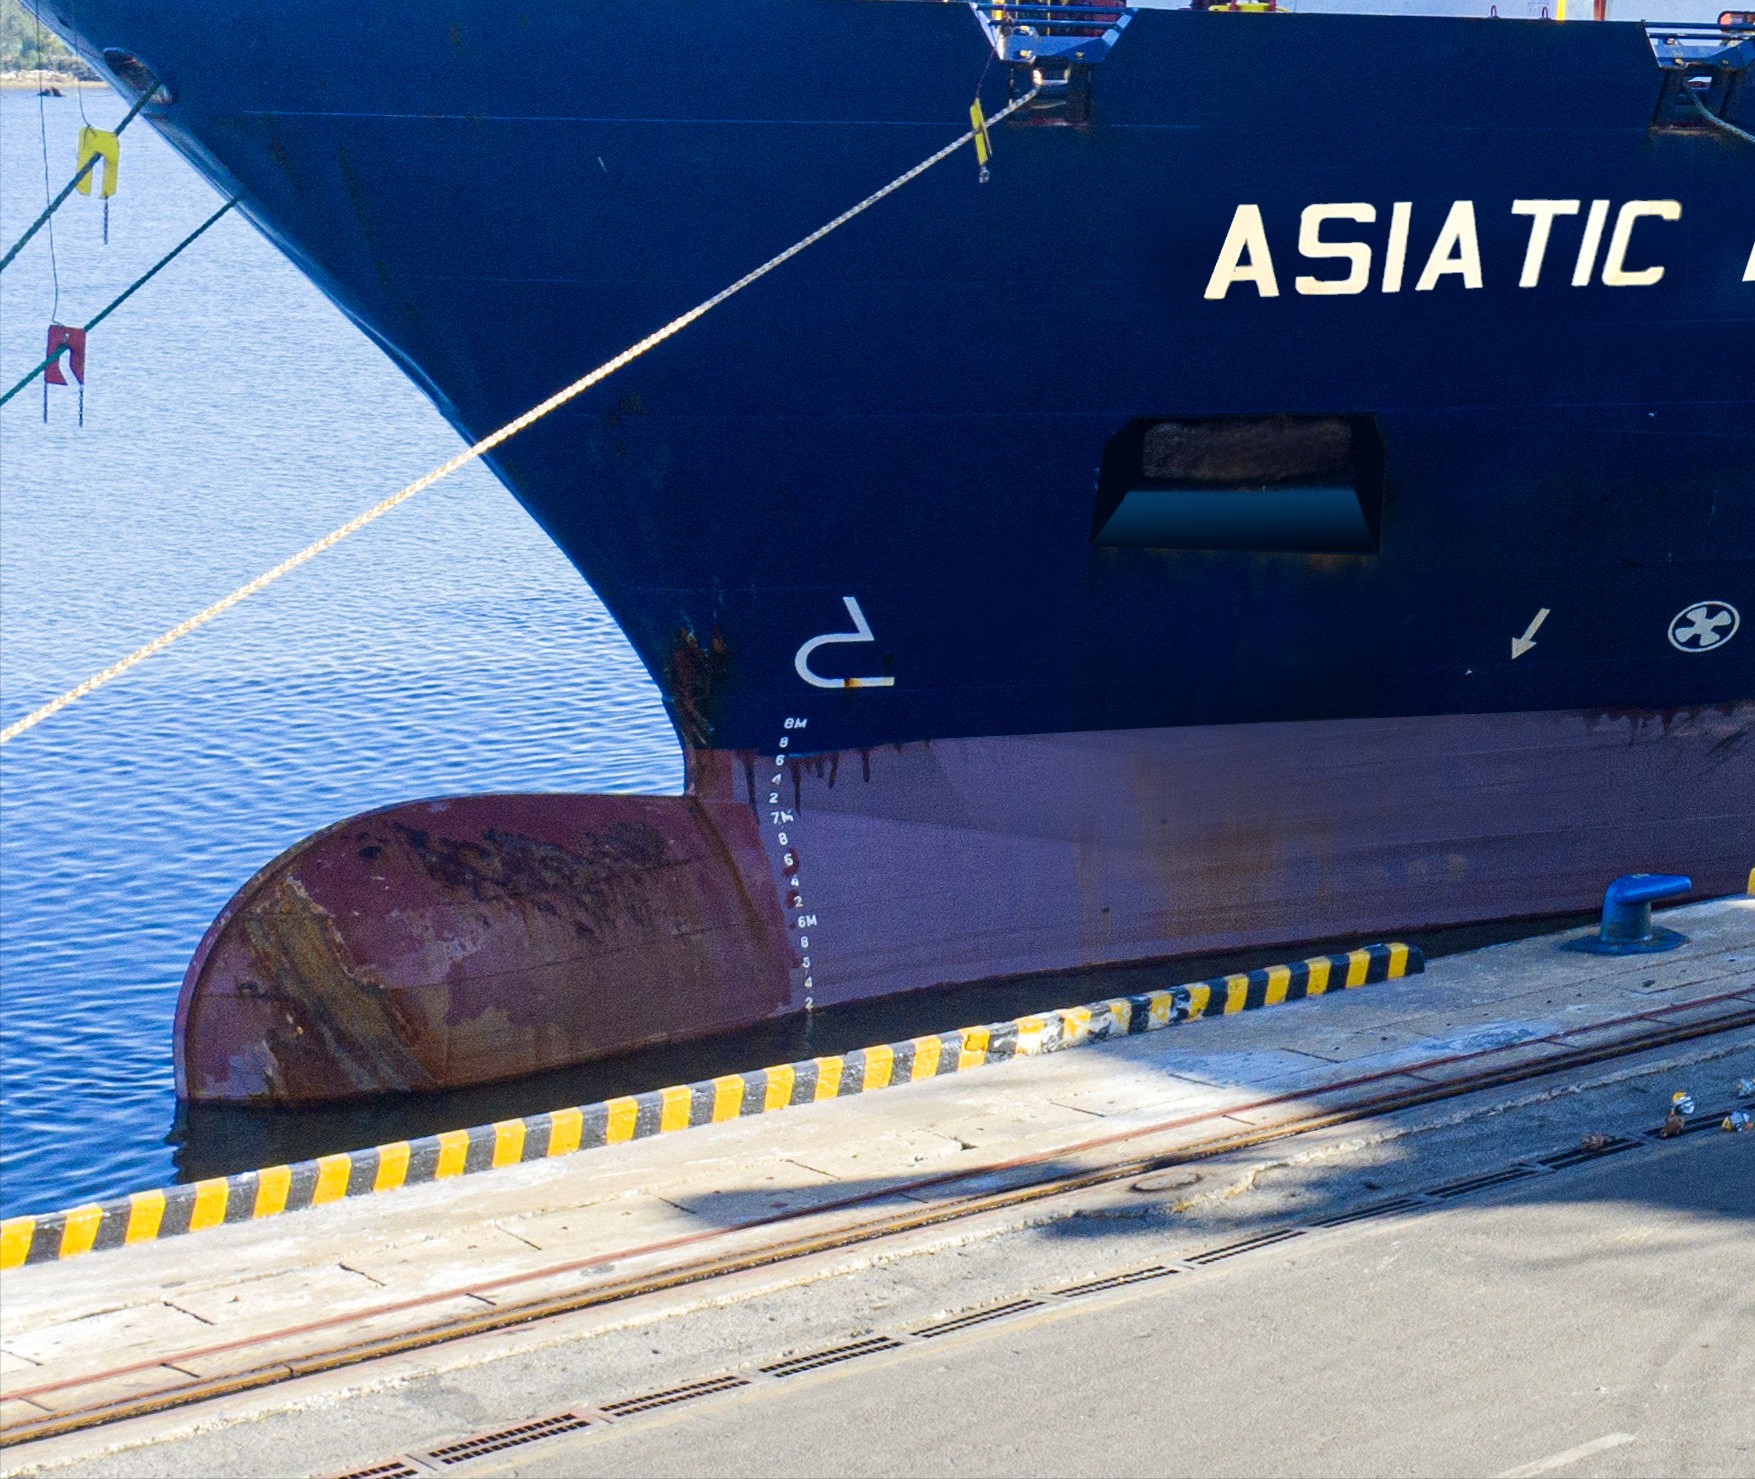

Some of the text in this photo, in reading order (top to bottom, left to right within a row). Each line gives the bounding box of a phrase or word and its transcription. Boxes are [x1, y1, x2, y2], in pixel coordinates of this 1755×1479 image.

[1203, 198, 1682, 300] ASIATIC
[783, 717, 808, 730] 8M
[778, 736, 789, 749] 8
[775, 754, 786, 767] 6
[771, 773, 782, 785] 4
[769, 792, 779, 804] 2
[778, 831, 788, 846] 8
[783, 853, 794, 867] 6
[790, 874, 800, 887] 4
[793, 895, 804, 909] 2
[797, 913, 818, 929] 6M
[800, 936, 809, 949] 8
[804, 976, 813, 988] 4
[804, 996, 814, 1009] 2
